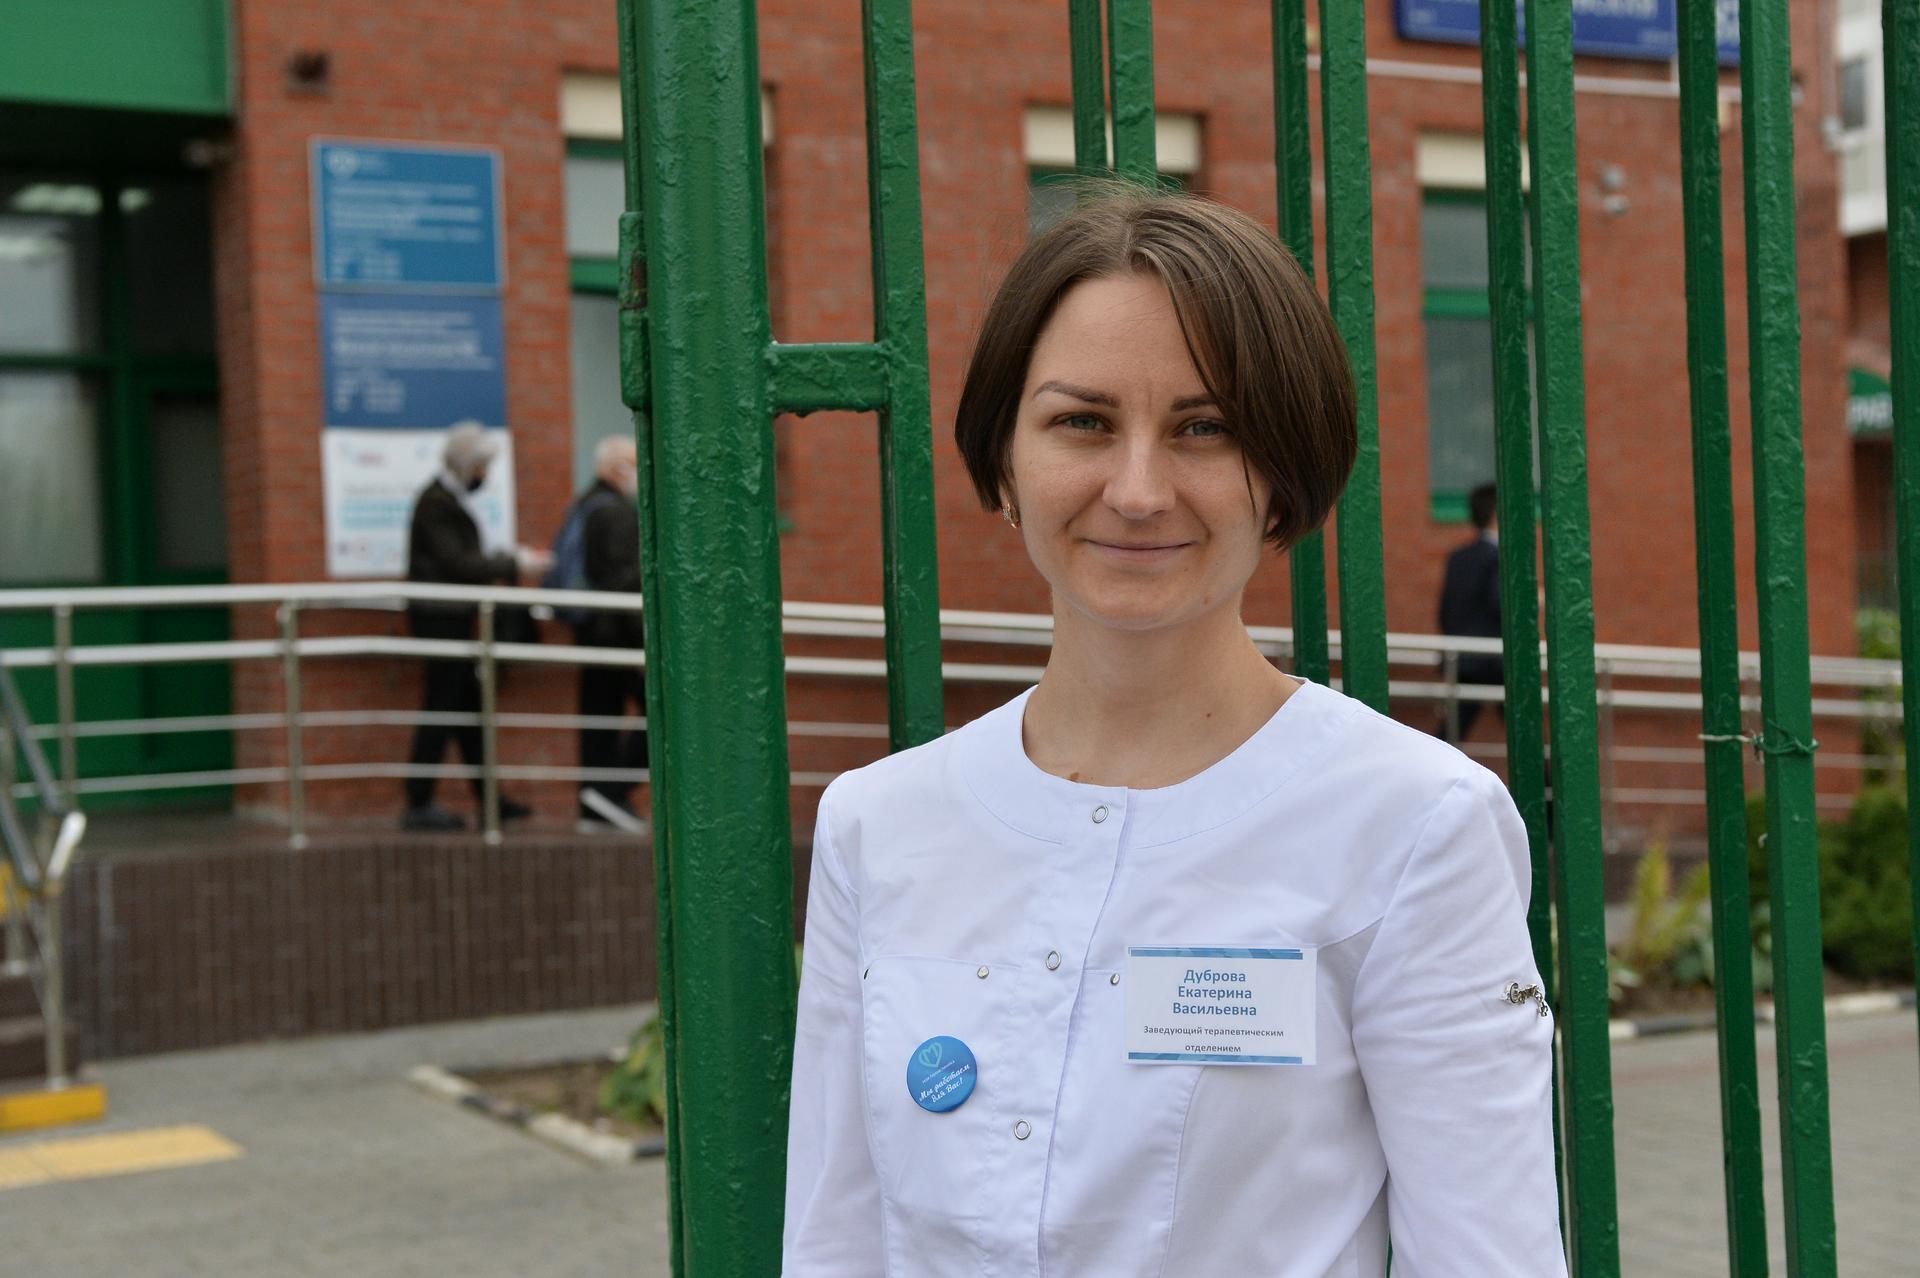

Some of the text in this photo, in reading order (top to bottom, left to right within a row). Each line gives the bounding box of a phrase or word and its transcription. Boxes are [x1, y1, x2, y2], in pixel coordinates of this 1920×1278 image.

[1184, 970, 1246, 984] Дуброва
[1178, 986, 1252, 1000] Екатерина
[1173, 1003, 1257, 1016] Васильевна
[1143, 1026, 1284, 1037] Заведующий терапевтическим
[1185, 1045, 1241, 1053] отделением
[934, 1064, 970, 1093] работаем
